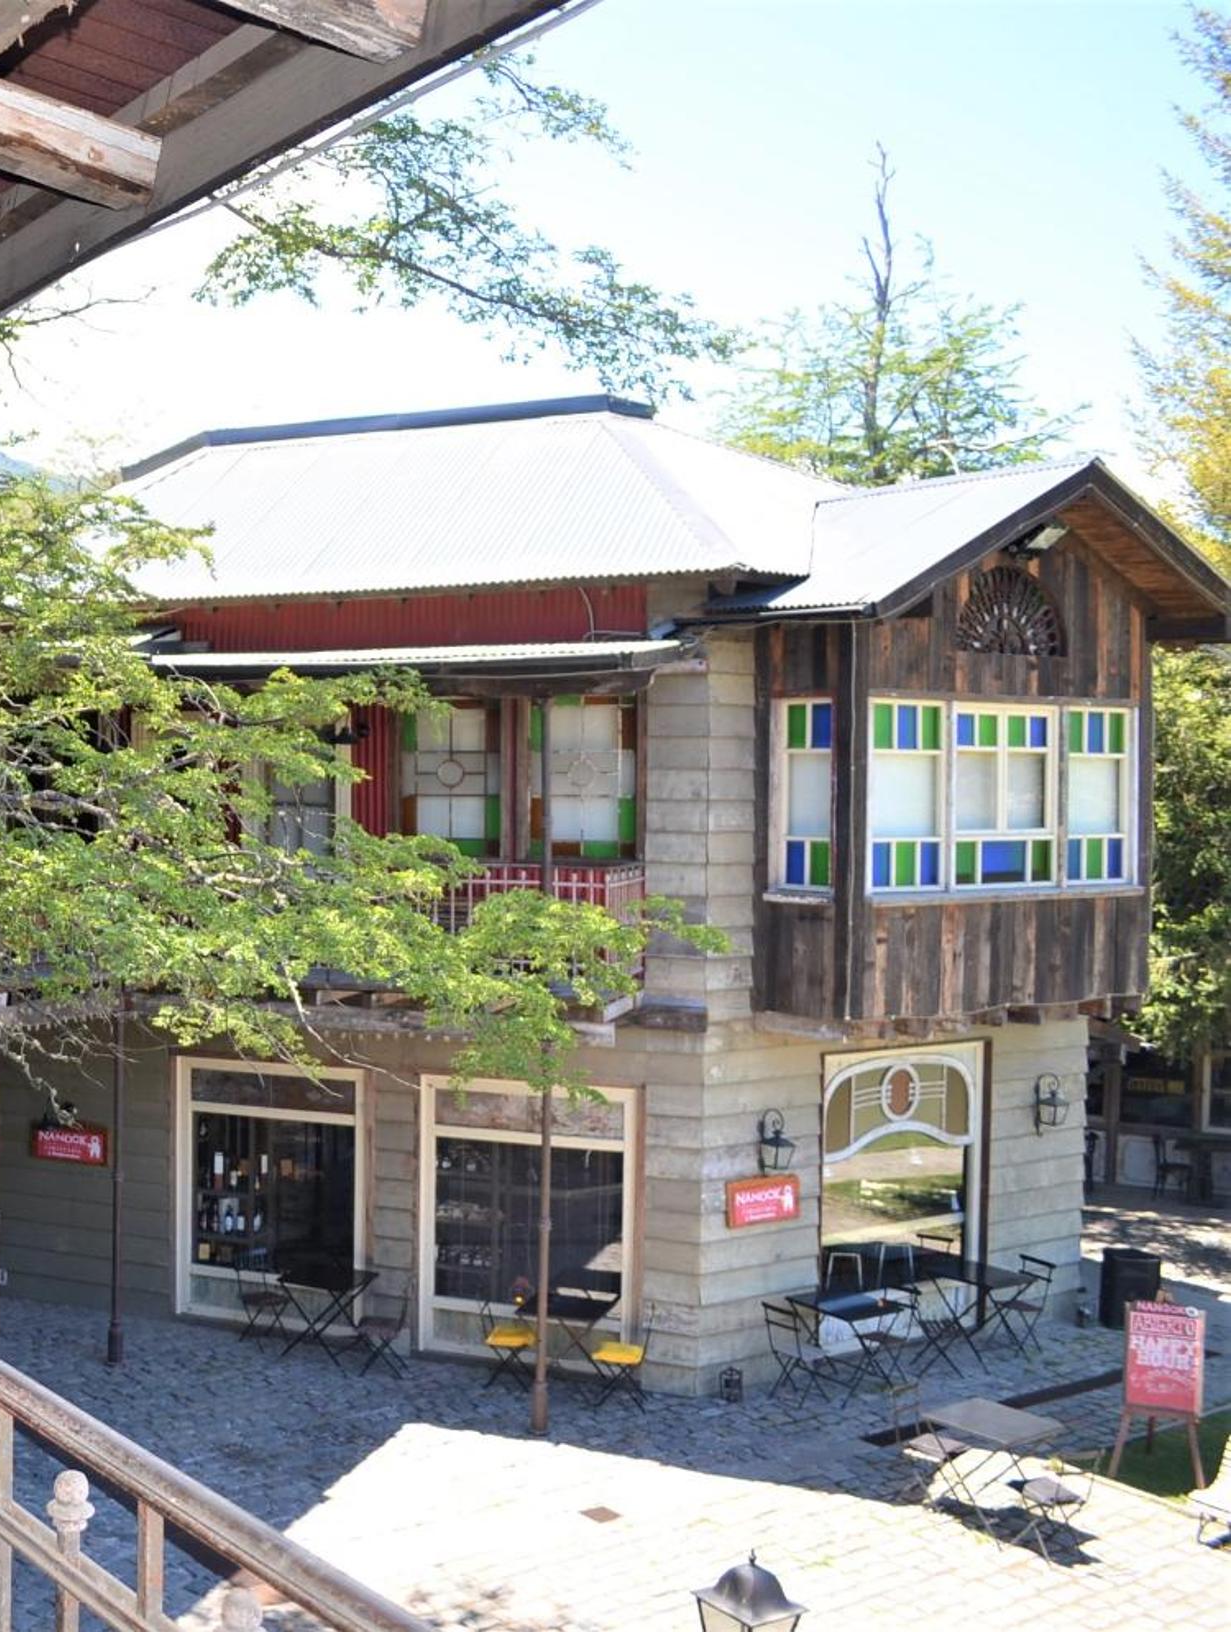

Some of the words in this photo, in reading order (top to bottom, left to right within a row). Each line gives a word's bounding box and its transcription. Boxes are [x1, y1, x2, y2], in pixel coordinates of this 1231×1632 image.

[38, 1131, 86, 1145] NANOOK
[735, 1187, 783, 1206] NANOOK
[1129, 1335, 1195, 1356] HAPPY
